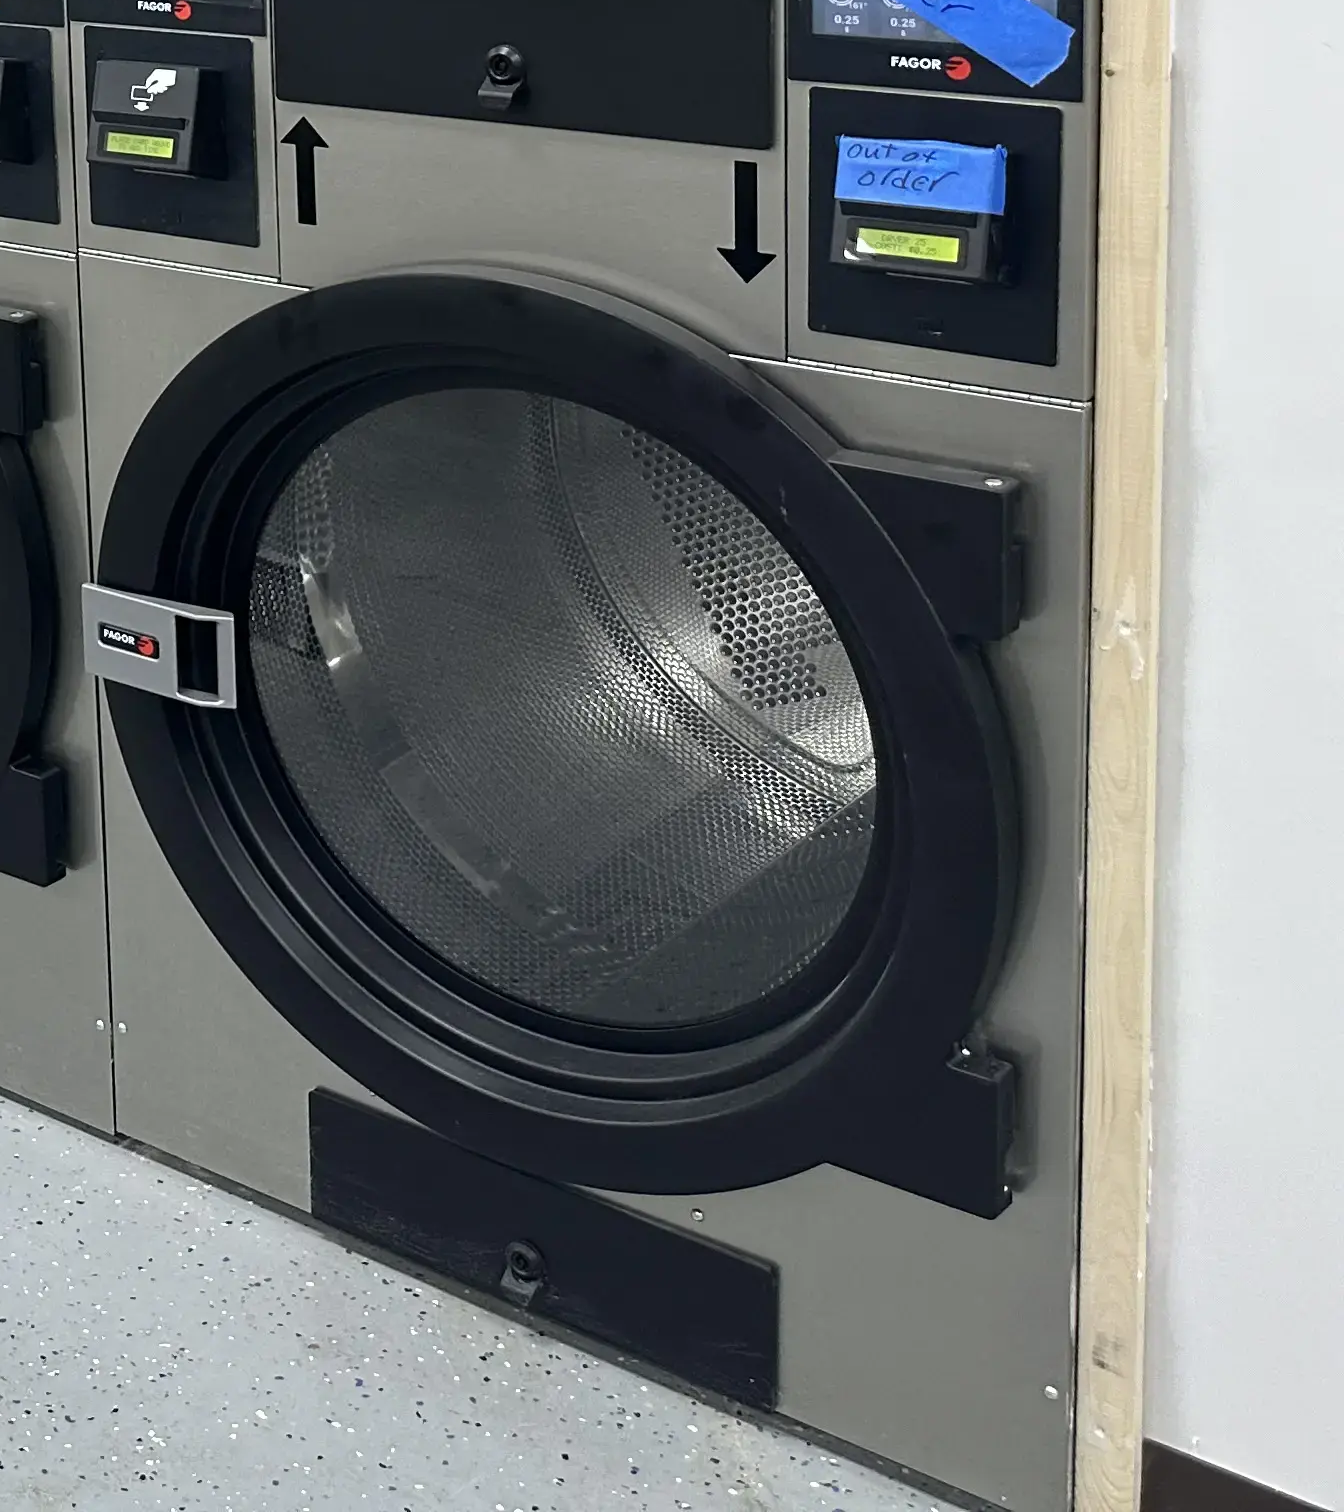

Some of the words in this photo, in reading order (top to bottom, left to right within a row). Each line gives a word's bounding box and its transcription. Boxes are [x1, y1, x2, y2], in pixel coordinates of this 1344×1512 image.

[137, 0, 172, 13] FAGOR
[833, 14, 861, 26] 0.25
[889, 17, 917, 29] 0.25
[890, 55, 942, 71] FAGOR
[857, 167, 961, 193] order
[103, 628, 136, 646] FAGOR
